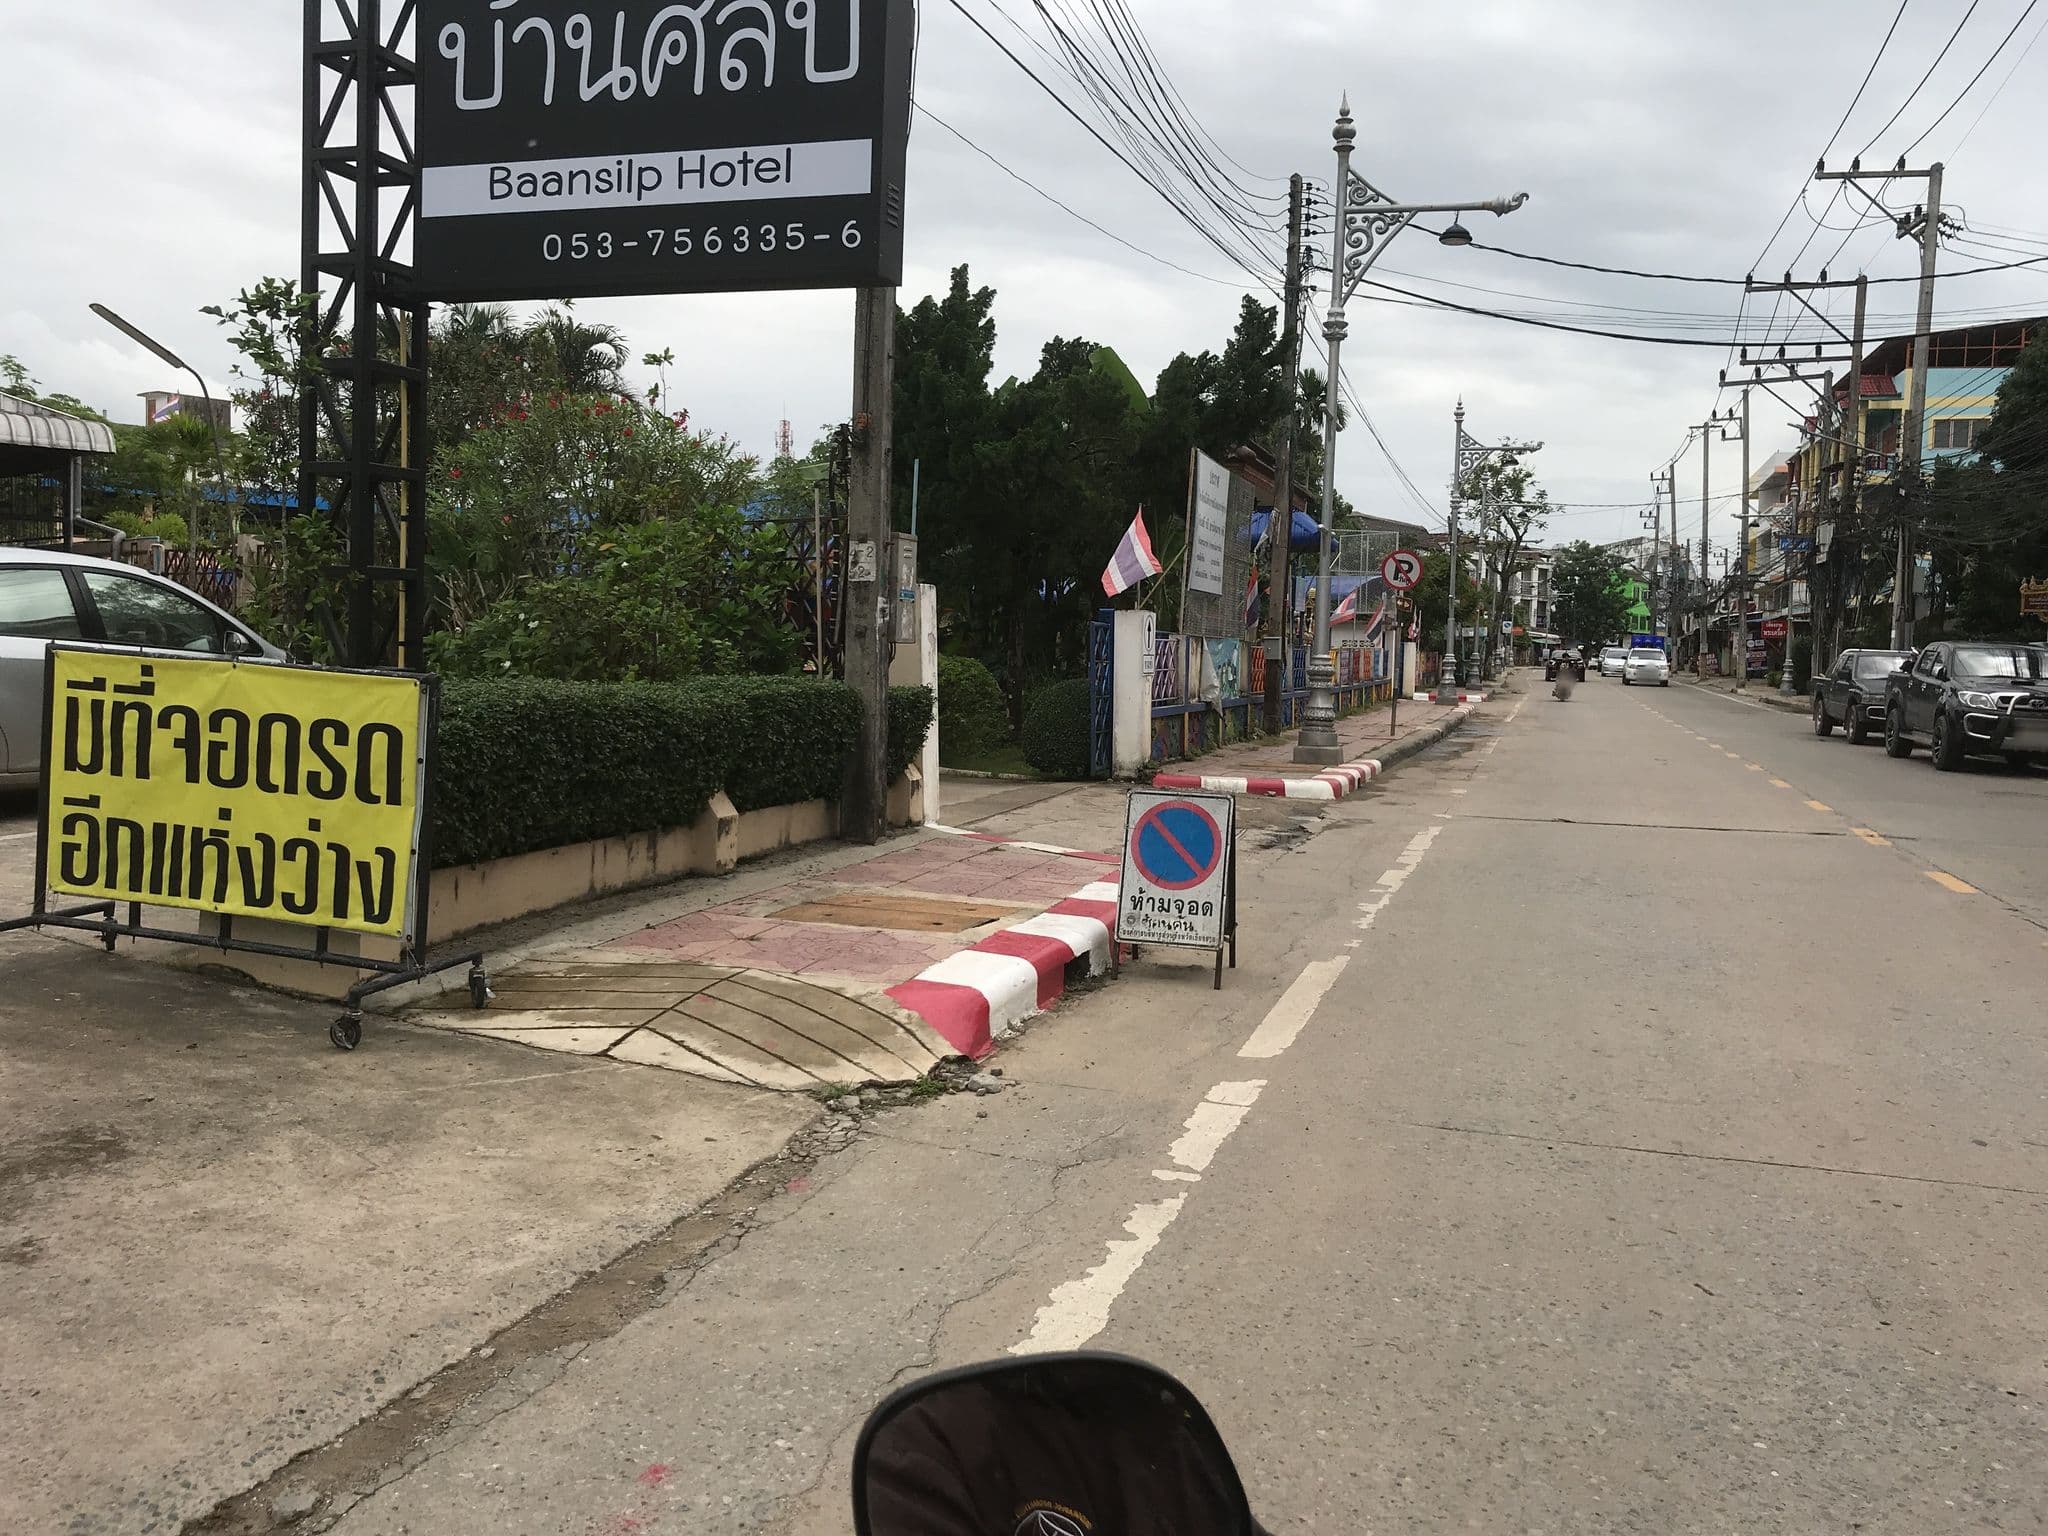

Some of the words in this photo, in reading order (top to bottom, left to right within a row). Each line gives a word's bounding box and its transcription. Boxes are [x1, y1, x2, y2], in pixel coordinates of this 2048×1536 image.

[489, 158, 662, 201] Baansilp
[677, 147, 792, 190] Hotel
[543, 220, 862, 261] 053-756335-6
[1130, 887, 1214, 917] ห้ามจอด
